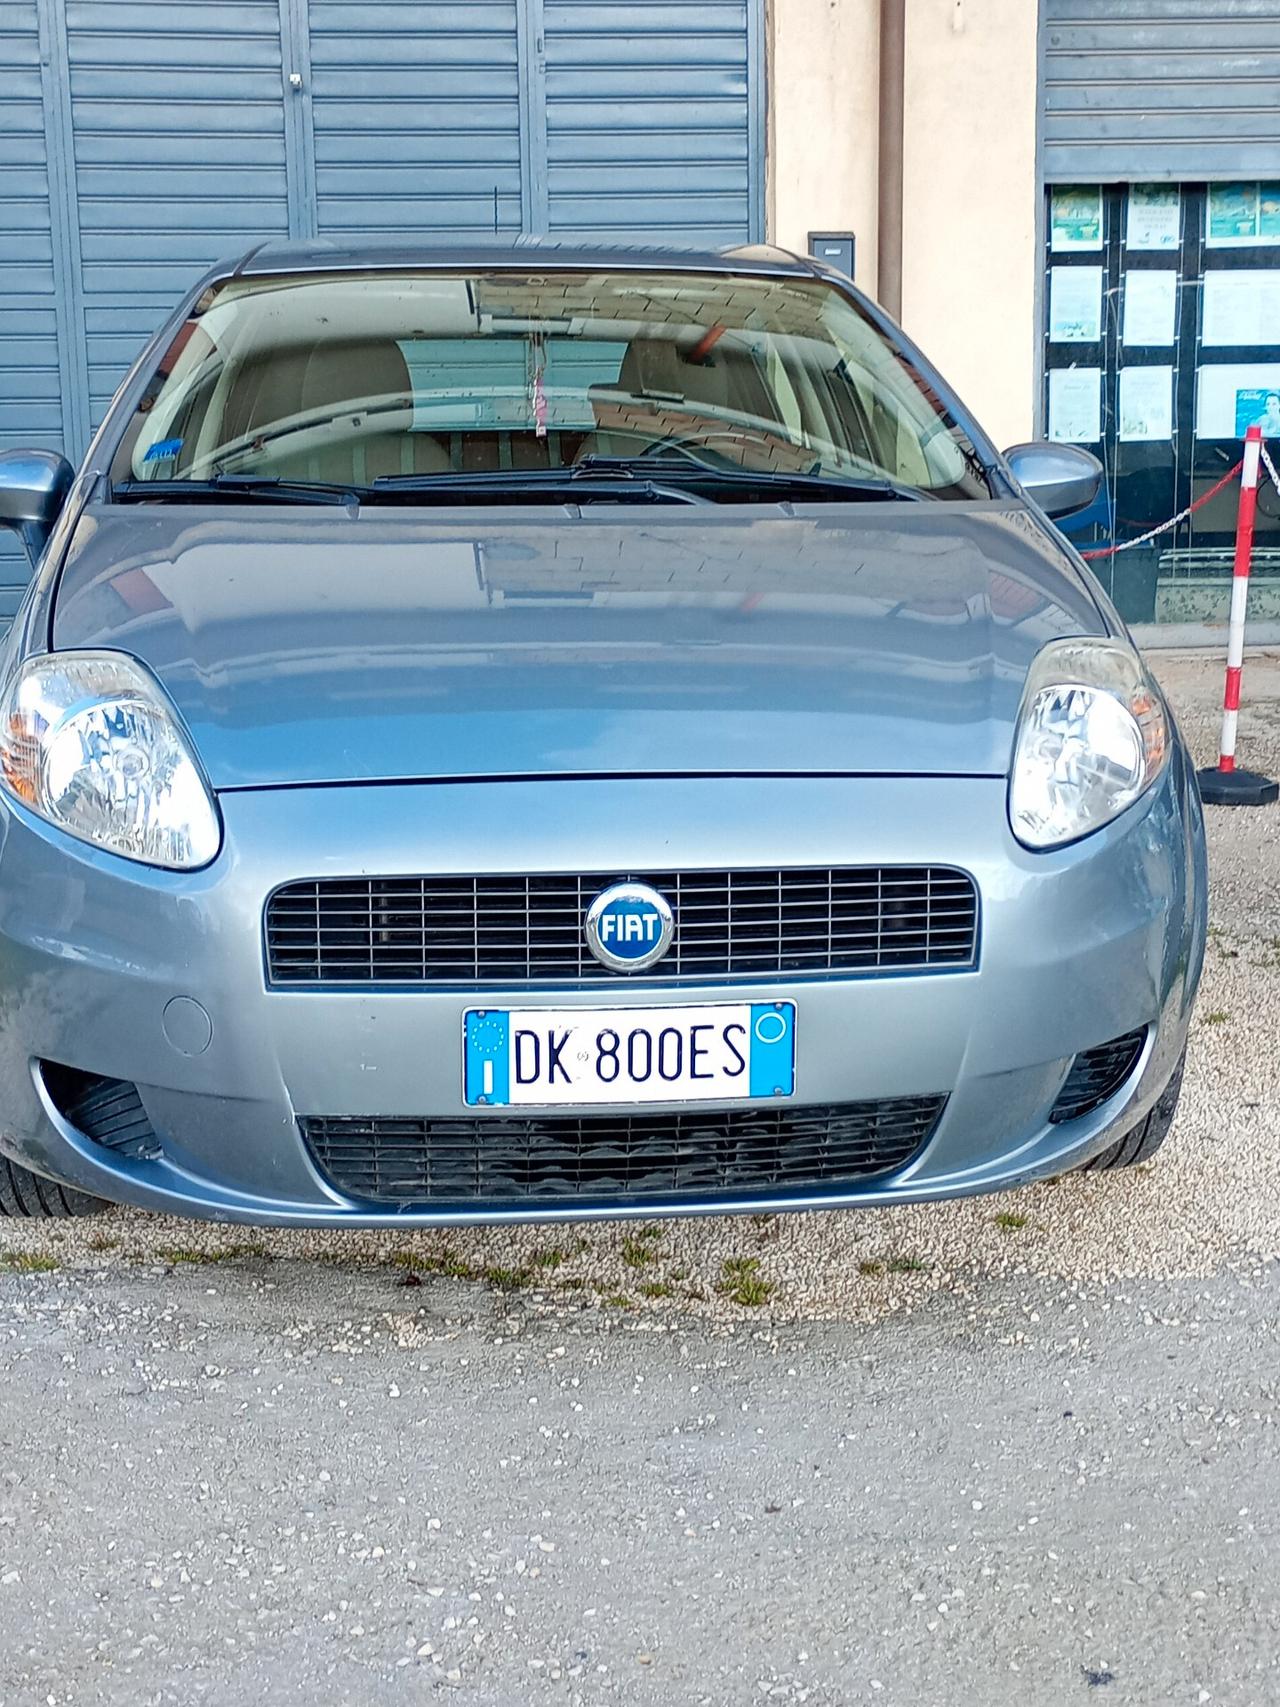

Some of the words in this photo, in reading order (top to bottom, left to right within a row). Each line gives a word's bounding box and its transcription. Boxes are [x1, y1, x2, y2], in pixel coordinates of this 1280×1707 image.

[602, 913, 658, 942] FIAT
[515, 1029, 573, 1085] DK
[595, 1023, 747, 1083] 800ES
